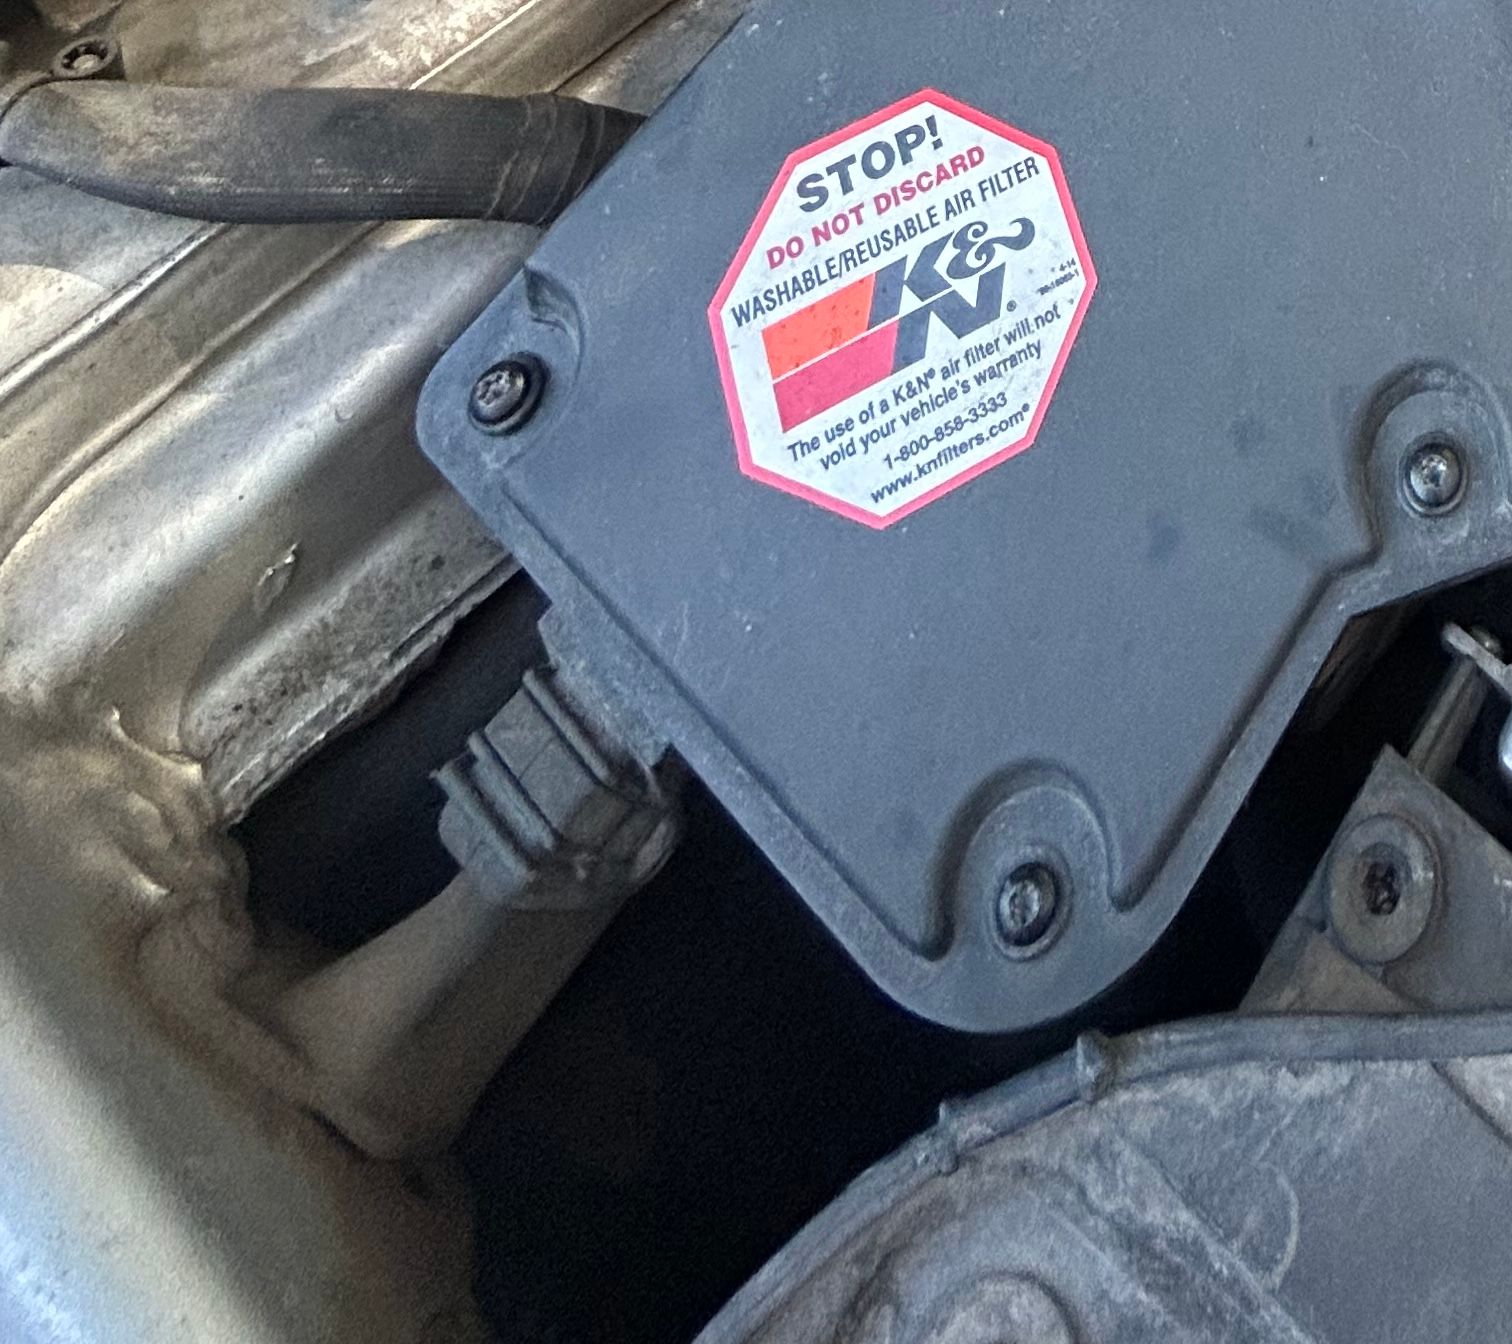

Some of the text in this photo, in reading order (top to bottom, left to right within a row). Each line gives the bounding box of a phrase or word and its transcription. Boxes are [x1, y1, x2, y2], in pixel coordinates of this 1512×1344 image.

[766, 145, 985, 270] DO NOT DISCARD
[796, 114, 944, 213] STOP!
[731, 156, 1040, 327] WASHABLE/REUSABLE AIR FILTER
[787, 436, 820, 462] The
[824, 417, 855, 443] use
[859, 401, 875, 424] of
[879, 399, 890, 414] a
[940, 358, 961, 380] air
[963, 337, 1001, 367] filter
[1003, 317, 1031, 345] will
[1034, 303, 1062, 330] not
[820, 339, 1042, 471] void your vehicle's warranty
[884, 392, 1008, 470] 1-800-858-3333
